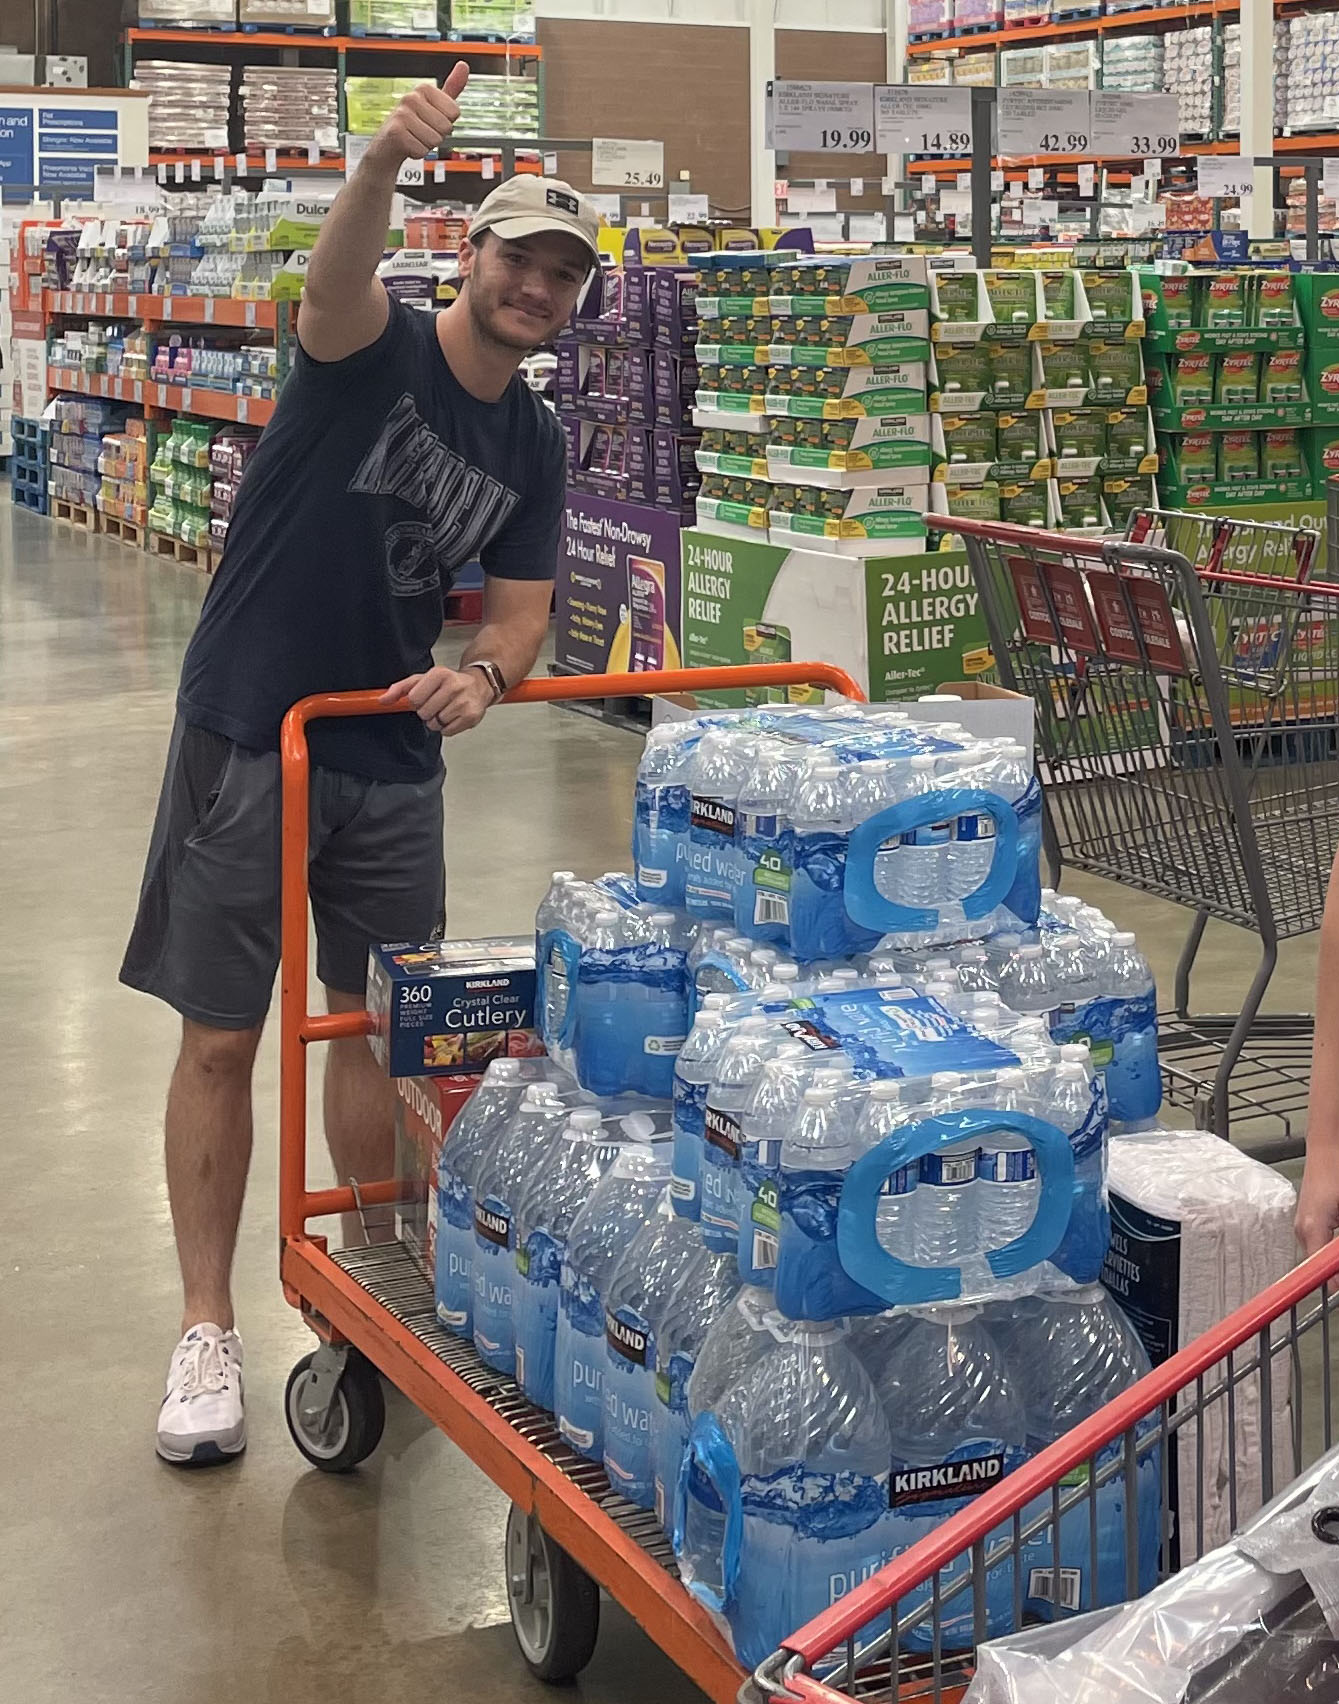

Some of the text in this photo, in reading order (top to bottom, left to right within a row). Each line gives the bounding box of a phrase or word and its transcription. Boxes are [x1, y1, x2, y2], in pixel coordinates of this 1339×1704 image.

[820, 129, 872, 149] 19.99
[920, 132, 970, 151] 14.89
[1039, 133, 1088, 152] 42.99
[1130, 136, 1178, 154] 33.99
[623, 172, 662, 186] 25.49
[1223, 184, 1254, 196] 24.99
[867, 270, 911, 282] ALLER-FLO
[1260, 279, 1290, 291] ZYRTEC
[1209, 280, 1239, 291] ZYRTEC
[869, 321, 913, 334] ALLER-FLO
[1177, 357, 1209, 368] ZYRTEC
[1223, 357, 1253, 367] ZYRTEC
[1269, 356, 1299, 367] ZYRTEC
[865, 373, 909, 386] ALLER-FLO
[872, 426, 915, 438] ALLER-FLO
[868, 496, 912, 508] ALLER-FLO
[565, 508, 578, 531] The
[603, 517, 652, 554] Non-Drowsy
[565, 536, 617, 568] 24 Hour Relief
[687, 544, 734, 574] 24-HOUR
[687, 571, 731, 600] ALLERGY
[688, 597, 722, 624] RELIEF
[881, 592, 979, 627] ALLERGY
[882, 624, 955, 656] RELIEF
[692, 800, 734, 826] RKLAND
[759, 854, 781, 871] 40
[465, 978, 510, 989] KIRKLAND
[399, 985, 433, 1003] 360
[452, 994, 521, 1009] Crystal Clear
[444, 1005, 527, 1028] Cutlery
[397, 1076, 443, 1142] OUTDOOR
[757, 1186, 777, 1206] 40
[1110, 1232, 1129, 1256] WELS
[895, 1458, 1001, 1493] KIRKLAND
